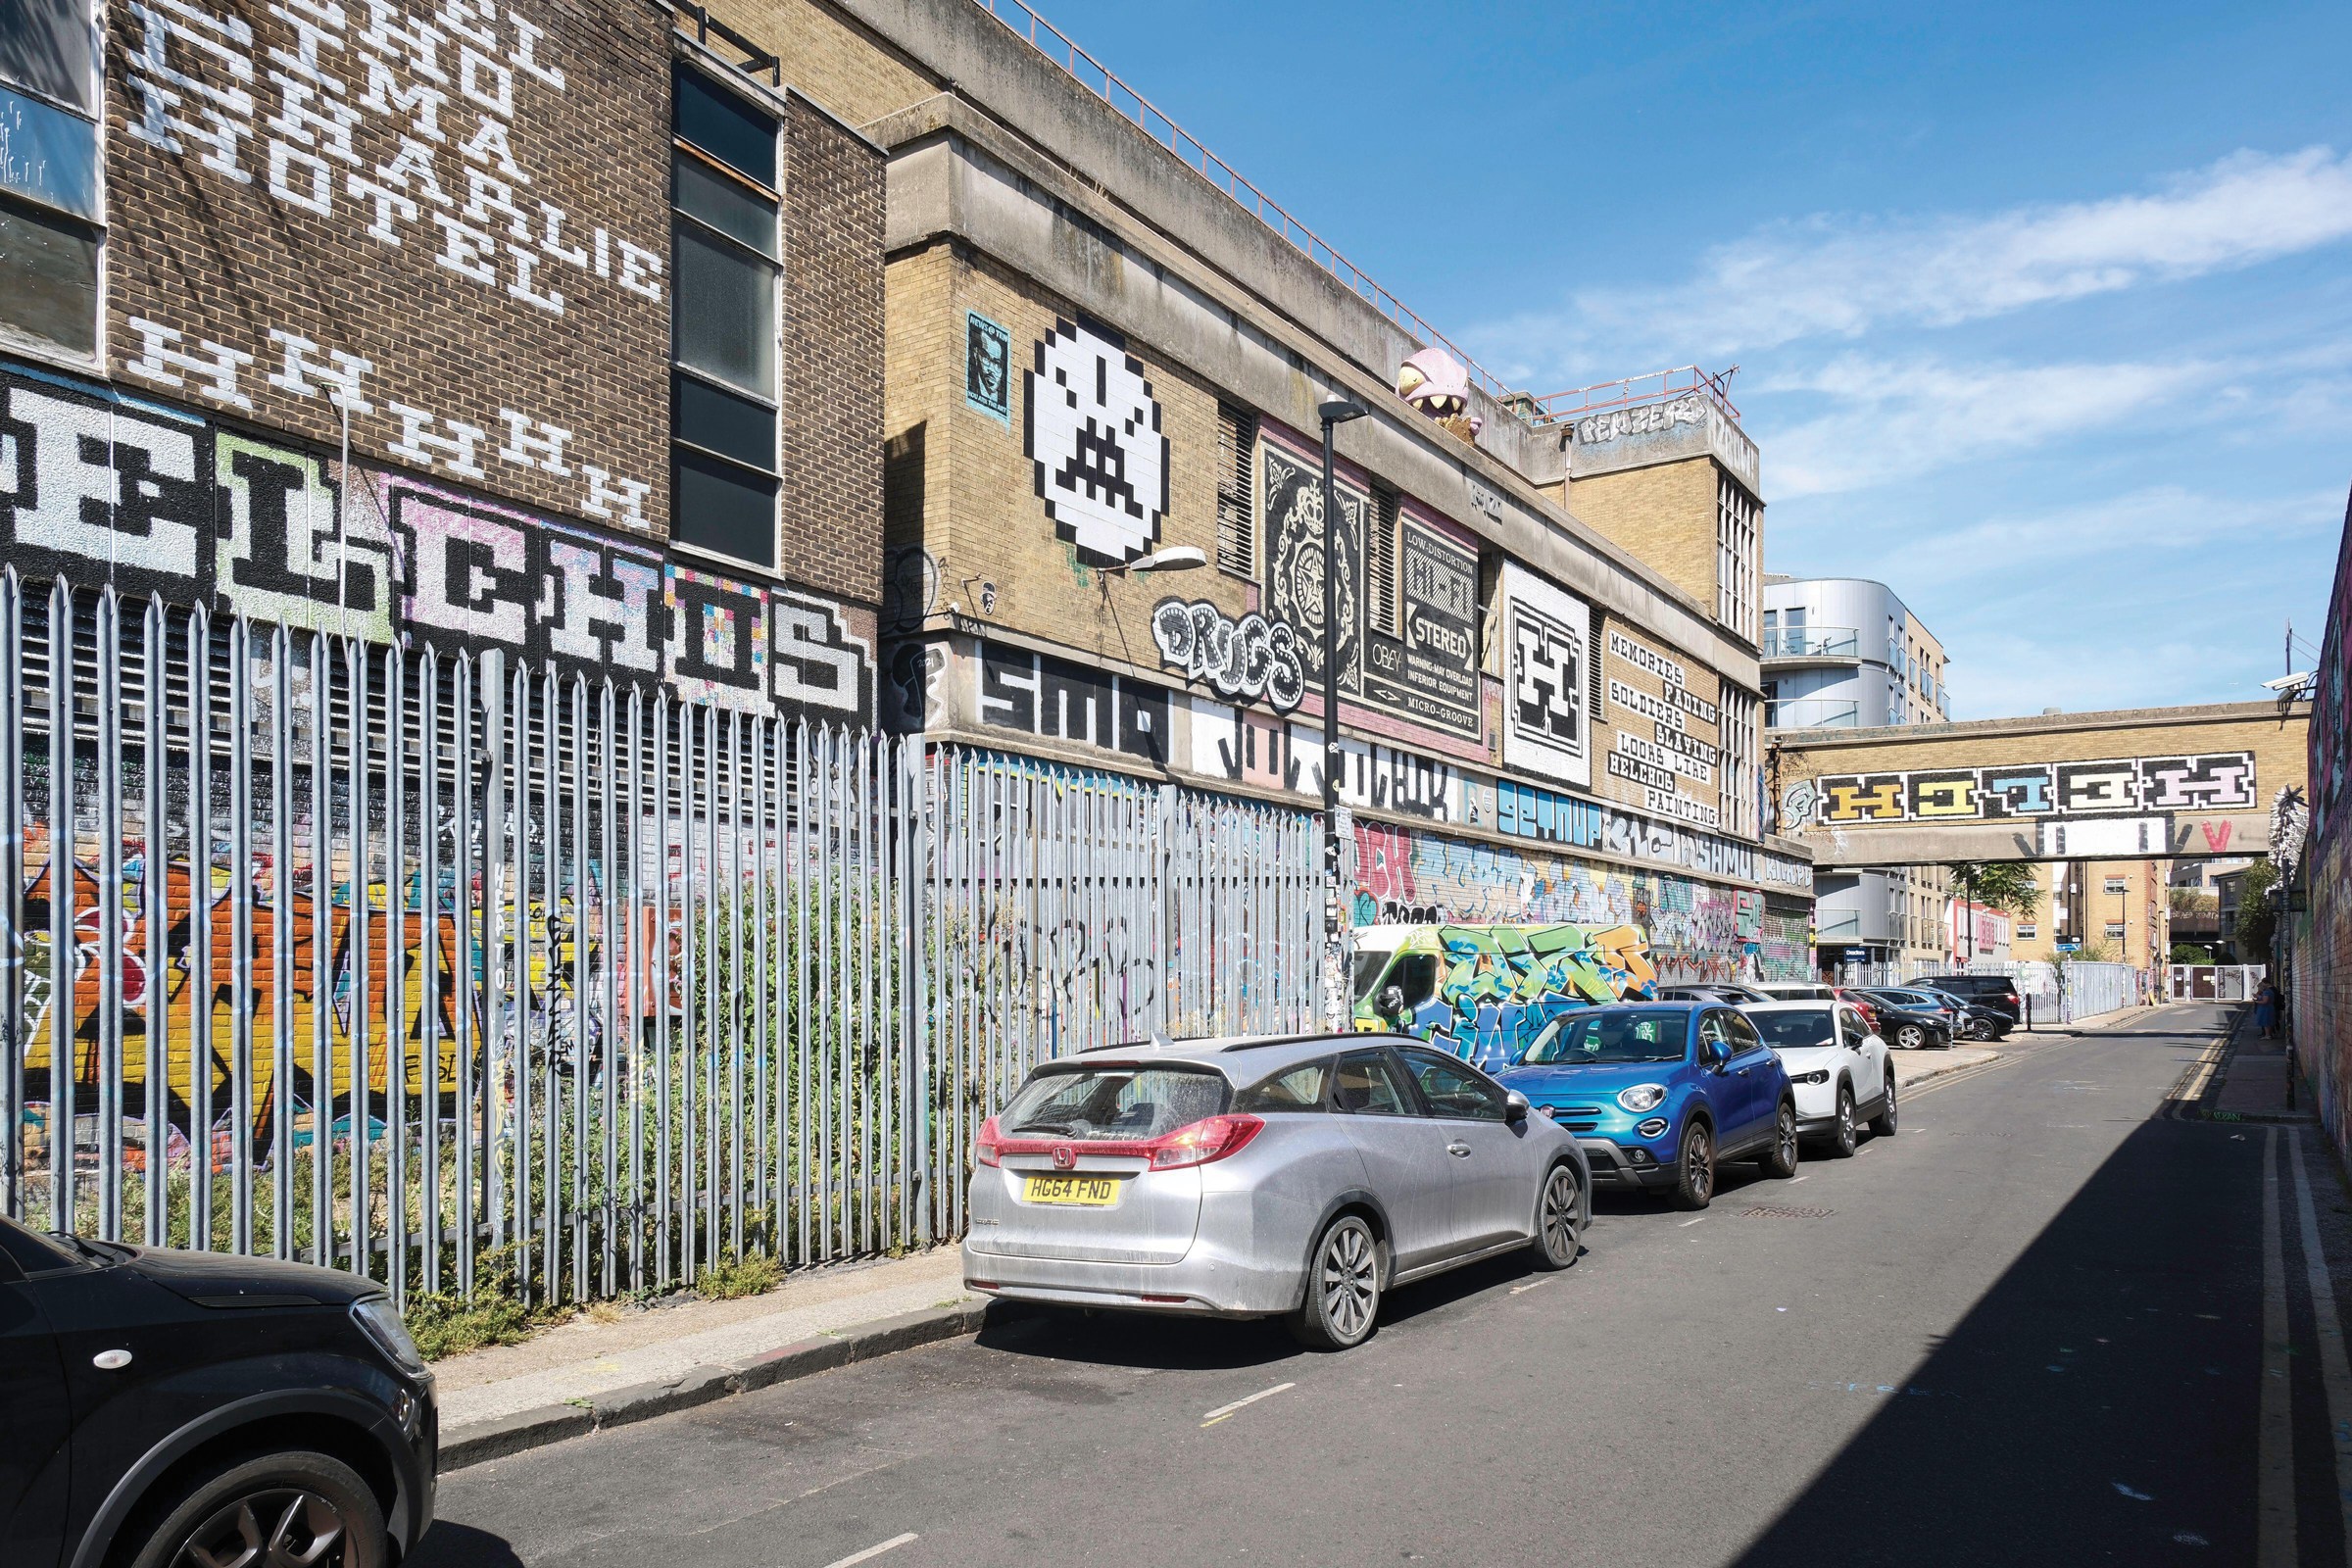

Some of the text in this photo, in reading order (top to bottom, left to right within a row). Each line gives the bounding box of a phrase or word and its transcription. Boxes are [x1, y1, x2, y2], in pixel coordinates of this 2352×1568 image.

[126, 73, 565, 316] HOTEL
[1407, 531, 1473, 575] LOW-DISTORTION
[1152, 599, 1305, 712] DRUGS
[1372, 643, 1401, 672] OBEY
[1415, 616, 1467, 660] STEREO
[1446, 668, 1473, 687] OVERLOAD
[1611, 632, 1683, 686] MEMORIES
[1407, 669, 1473, 702] INFERIOR EQUIPMENT
[1611, 682, 1683, 729] SOLDIERS
[1664, 681, 1716, 723] FADING
[1407, 697, 1473, 727] MICRO-GROOVE
[1655, 723, 1716, 765] SLAYING
[1609, 753, 1674, 792] HELCHOS
[1674, 754, 1707, 782] LIKE
[1647, 789, 1716, 825] PAINTING
[1030, 1178, 1112, 1200] HG64 FND
